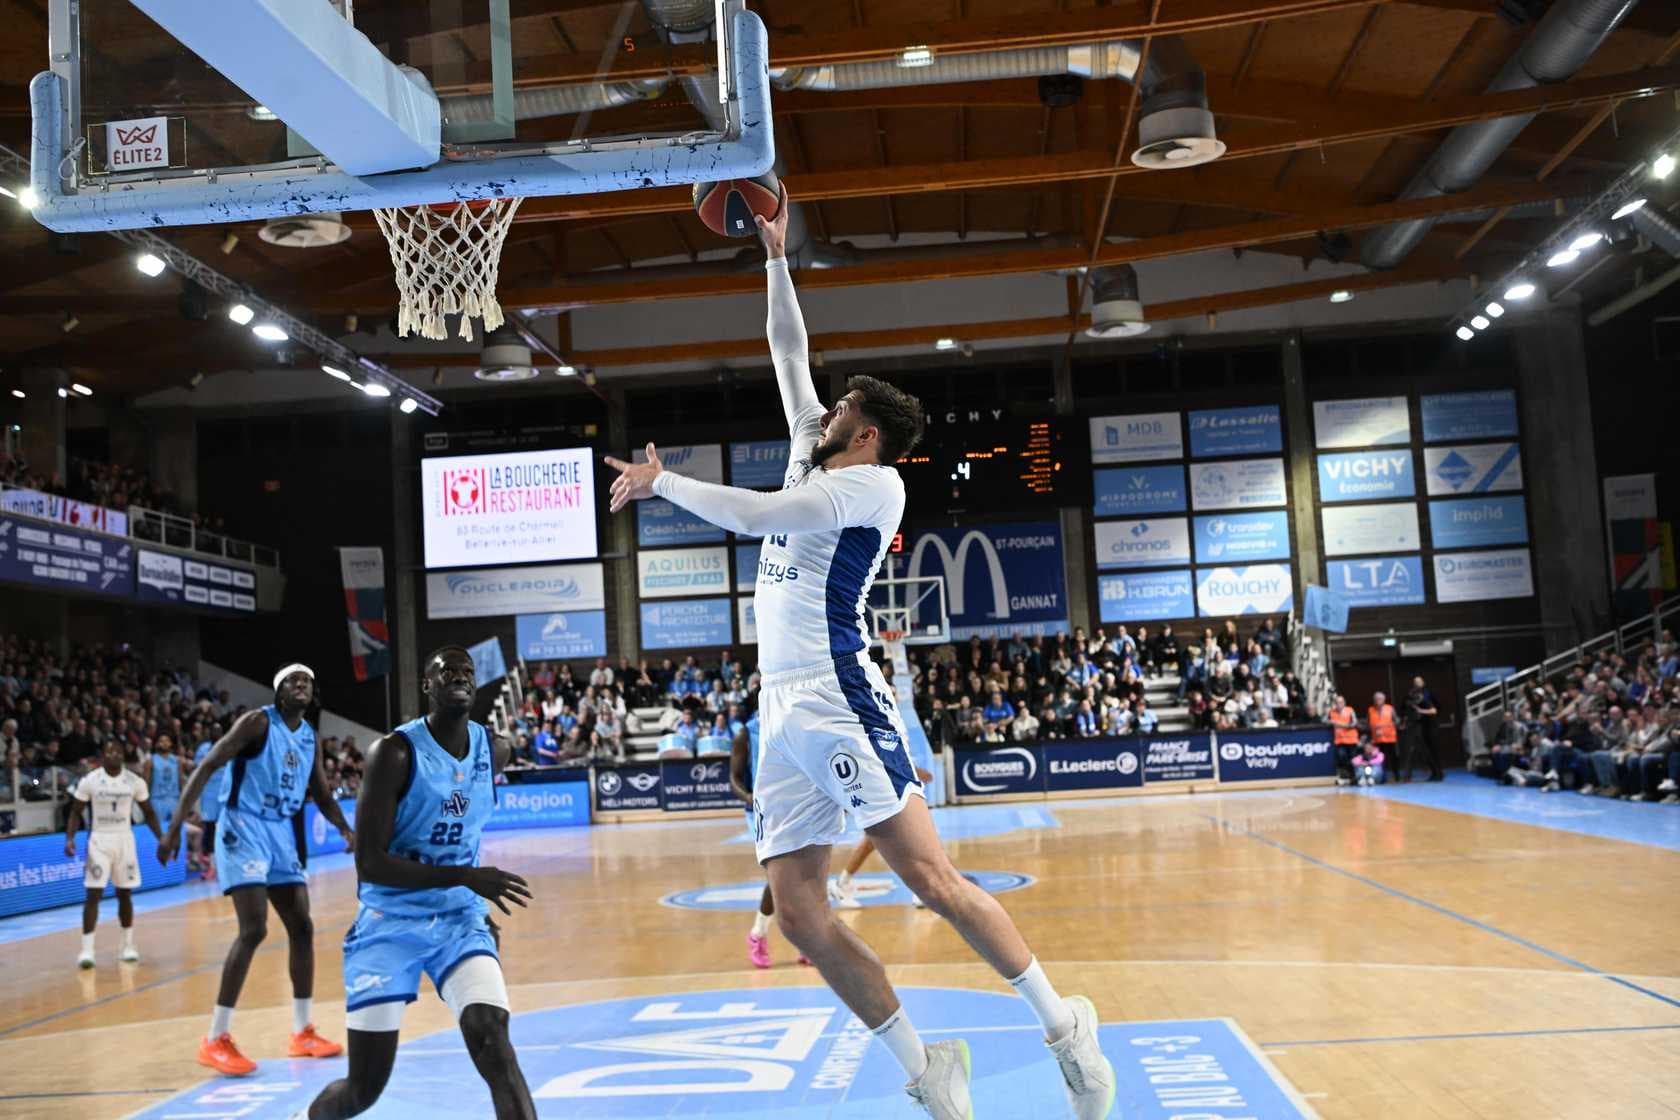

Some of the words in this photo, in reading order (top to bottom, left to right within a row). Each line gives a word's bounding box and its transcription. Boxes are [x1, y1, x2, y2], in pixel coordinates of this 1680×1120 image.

[926, 409, 1001, 424] ICHY
[1127, 422, 1162, 435] MDB
[489, 466, 502, 489] LA
[504, 462, 581, 488] BOUCHERIE
[1324, 456, 1407, 479] VICHY
[490, 486, 582, 513] RESTAURANT
[1112, 538, 1171, 554] chronos
[647, 555, 721, 573] AQUILUS
[1343, 560, 1410, 589] LTA
[1208, 579, 1281, 598] ROUCHY
[1011, 593, 1058, 610] GANNAT
[1149, 740, 1190, 752] FRANCE
[1244, 742, 1331, 757] boulanger
[1050, 759, 1117, 774] E.Leclerc
[1145, 751, 1209, 765] PARE-BRISE
[1245, 757, 1279, 769] Vichy
[835, 759, 851, 779] U
[665, 785, 694, 795] VICHY
[696, 782, 731, 793] RESIDE
[504, 792, 573, 812] Région
[429, 821, 464, 845] 22
[1139, 1054, 1230, 1084] BAC
